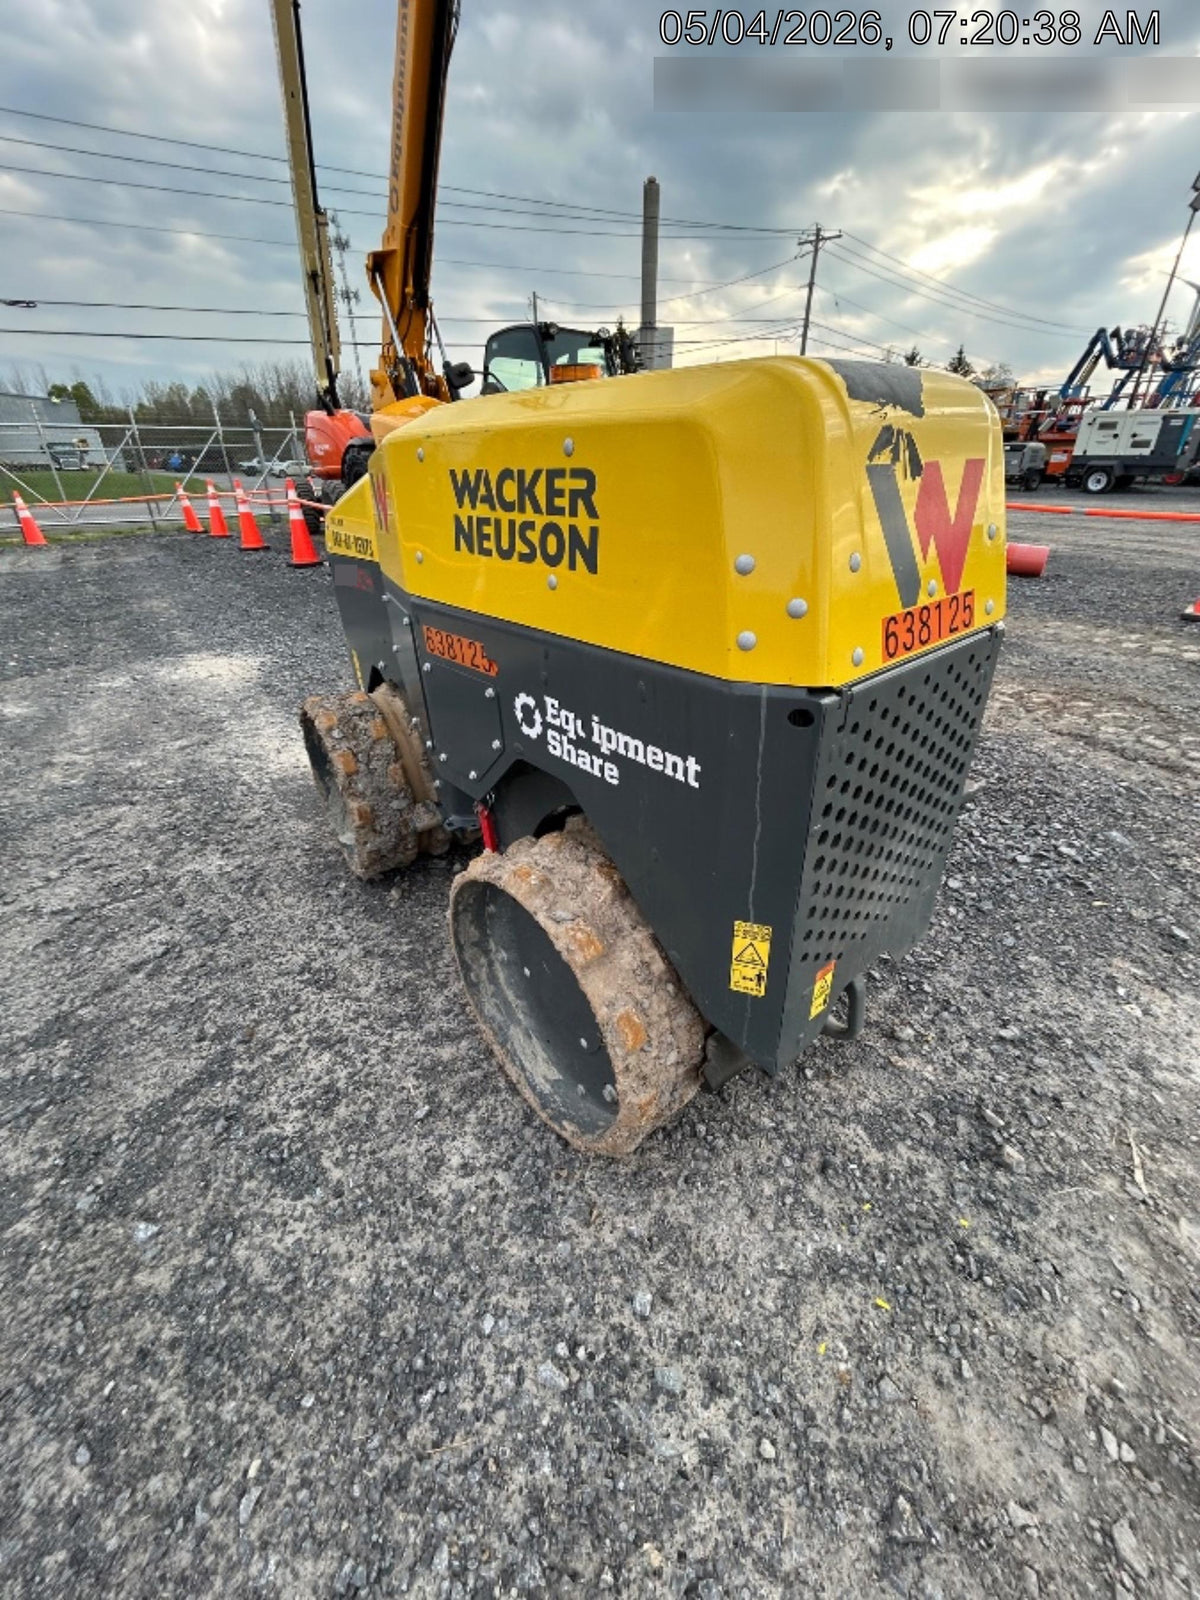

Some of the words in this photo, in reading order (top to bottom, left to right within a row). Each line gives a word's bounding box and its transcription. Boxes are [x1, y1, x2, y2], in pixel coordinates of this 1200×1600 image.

[449, 467, 599, 519] WACKER
[454, 514, 599, 575] NEUSON
[426, 626, 492, 673] 638125
[885, 591, 974, 659] 638125
[547, 729, 620, 785] Share
